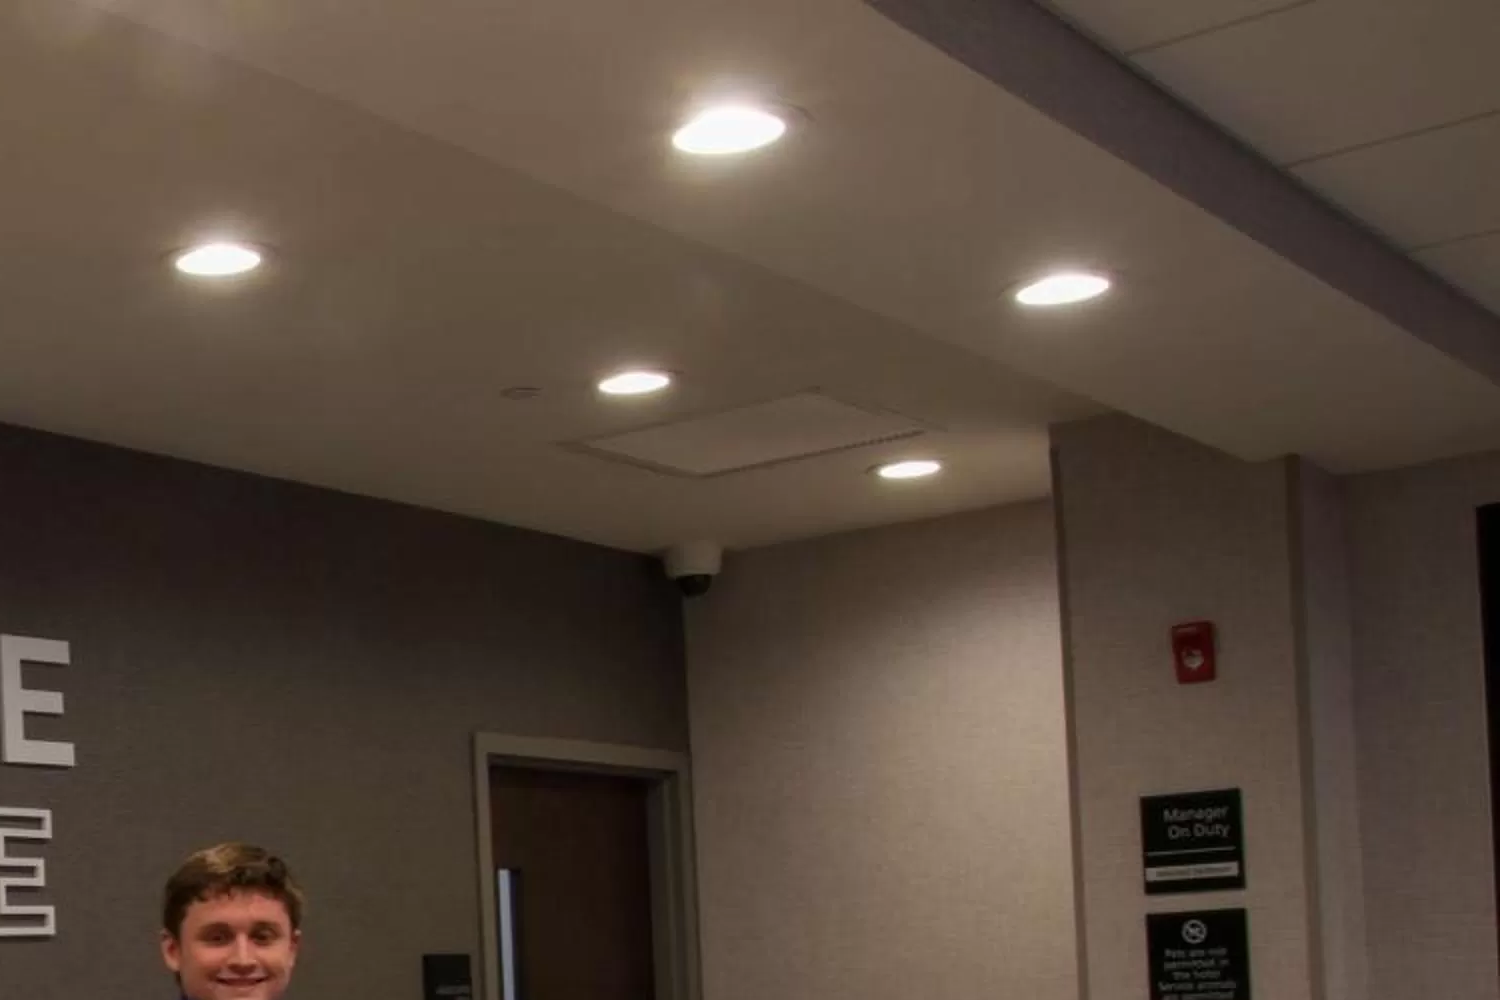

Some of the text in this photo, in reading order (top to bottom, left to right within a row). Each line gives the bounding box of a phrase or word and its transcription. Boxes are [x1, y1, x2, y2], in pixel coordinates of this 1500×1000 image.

[1163, 805, 1229, 823] Manager
[1167, 823, 1231, 840] On Duty
